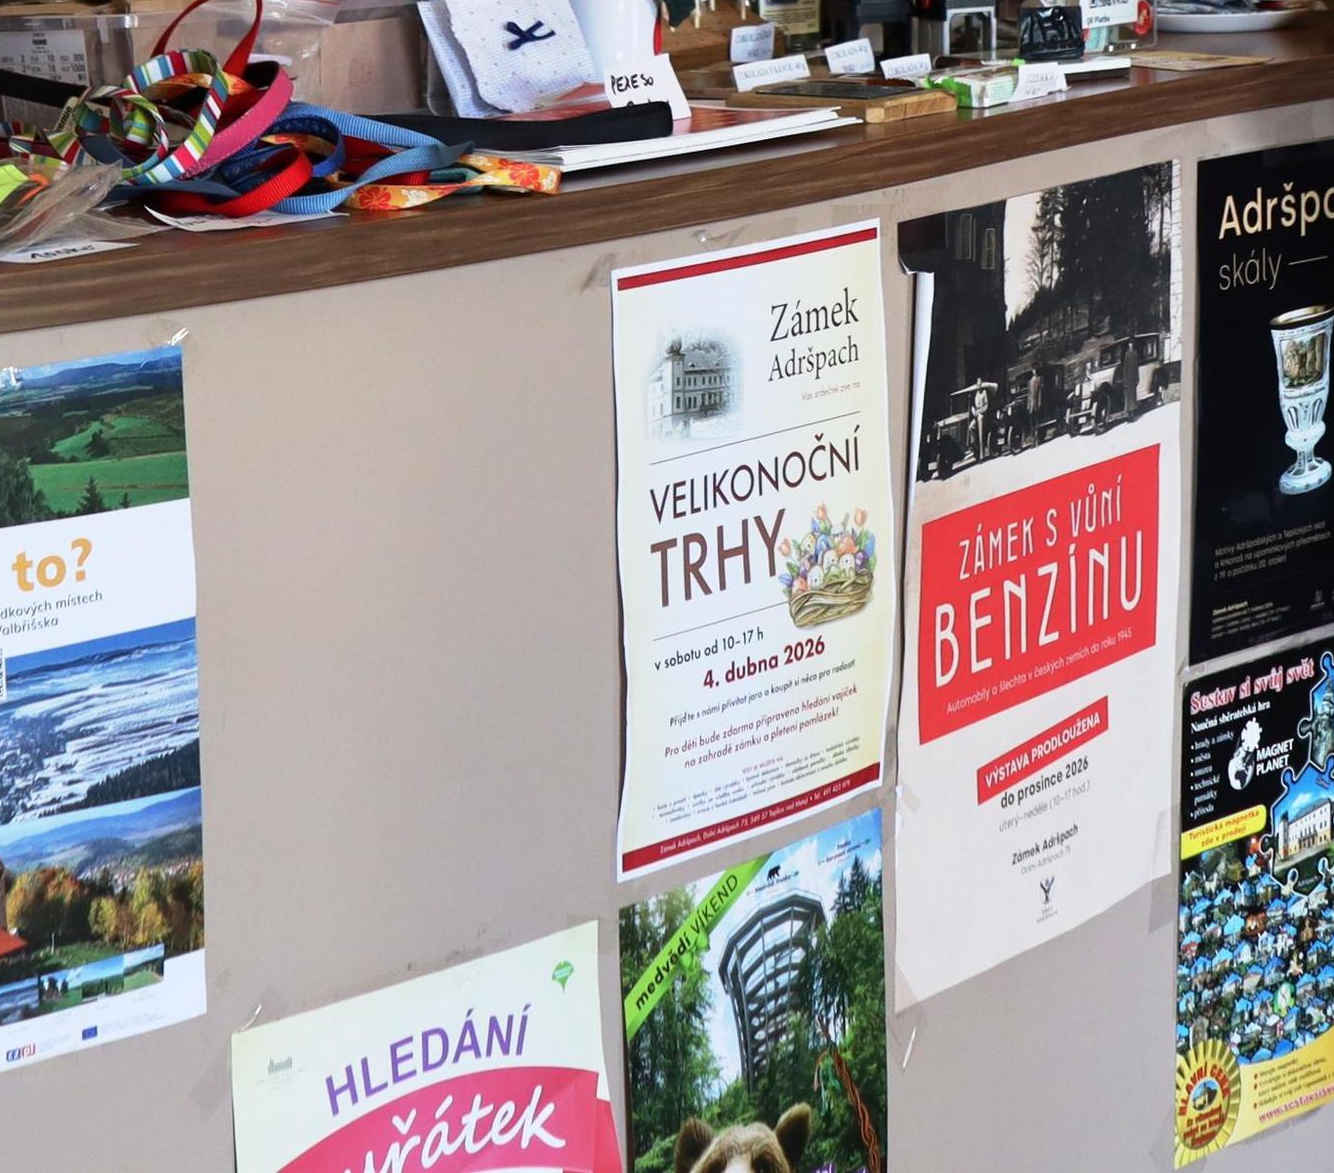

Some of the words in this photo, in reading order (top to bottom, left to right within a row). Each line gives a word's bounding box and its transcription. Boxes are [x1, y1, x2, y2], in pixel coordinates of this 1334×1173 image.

[1217, 246, 1282, 291] skály
[769, 285, 860, 342] Zámek
[767, 333, 859, 382] Adršpach
[648, 423, 861, 524] VELIKONOČNÍ
[958, 515, 1034, 580] ZÁMEK
[1045, 507, 1057, 547] S
[1068, 473, 1122, 547] VŮNÍ
[10, 536, 93, 592] to?
[648, 505, 787, 614] TRHY
[54, 588, 103, 610] místech
[934, 529, 1142, 688] BENZÍNU
[653, 660, 662, 671] v
[663, 648, 701, 669] sobotu
[702, 637, 719, 657] od
[721, 628, 754, 651] 10–17
[755, 625, 764, 641] h
[702, 668, 720, 689] 4.
[723, 653, 779, 684] dubna
[782, 634, 825, 666] 2026
[1189, 683, 1238, 715] Sestav
[1237, 674, 1253, 701] si
[1252, 666, 1286, 696] svůj
[1285, 656, 1316, 685] svět
[663, 745, 680, 759] Pro
[680, 737, 698, 753] děti
[697, 728, 721, 747] bude
[721, 720, 755, 739] zdarma
[754, 705, 800, 731] připraveno
[800, 694, 831, 712] hledání
[830, 682, 858, 702] vajíček
[683, 757, 696, 769] na
[697, 742, 733, 765] zahradě
[733, 733, 762, 753] zámku
[761, 732, 770, 742] a
[769, 722, 798, 743] pletení
[797, 704, 839, 733] pomlázek!
[984, 751, 1030, 788] VÝSTAVA
[1030, 710, 1101, 763] PRODLOUŽENA
[1255, 736, 1295, 763] MAGNET
[999, 785, 1016, 811] do
[1015, 764, 1064, 807] prosince
[1063, 752, 1090, 781] 2026
[1255, 751, 1290, 777] PLANET
[1010, 841, 1041, 866] Zámek
[1041, 822, 1079, 852] Adršpach
[634, 930, 691, 1011] medvědí
[690, 872, 740, 936] VÍKEND
[325, 1002, 535, 1117] HLEDÁNÍ
